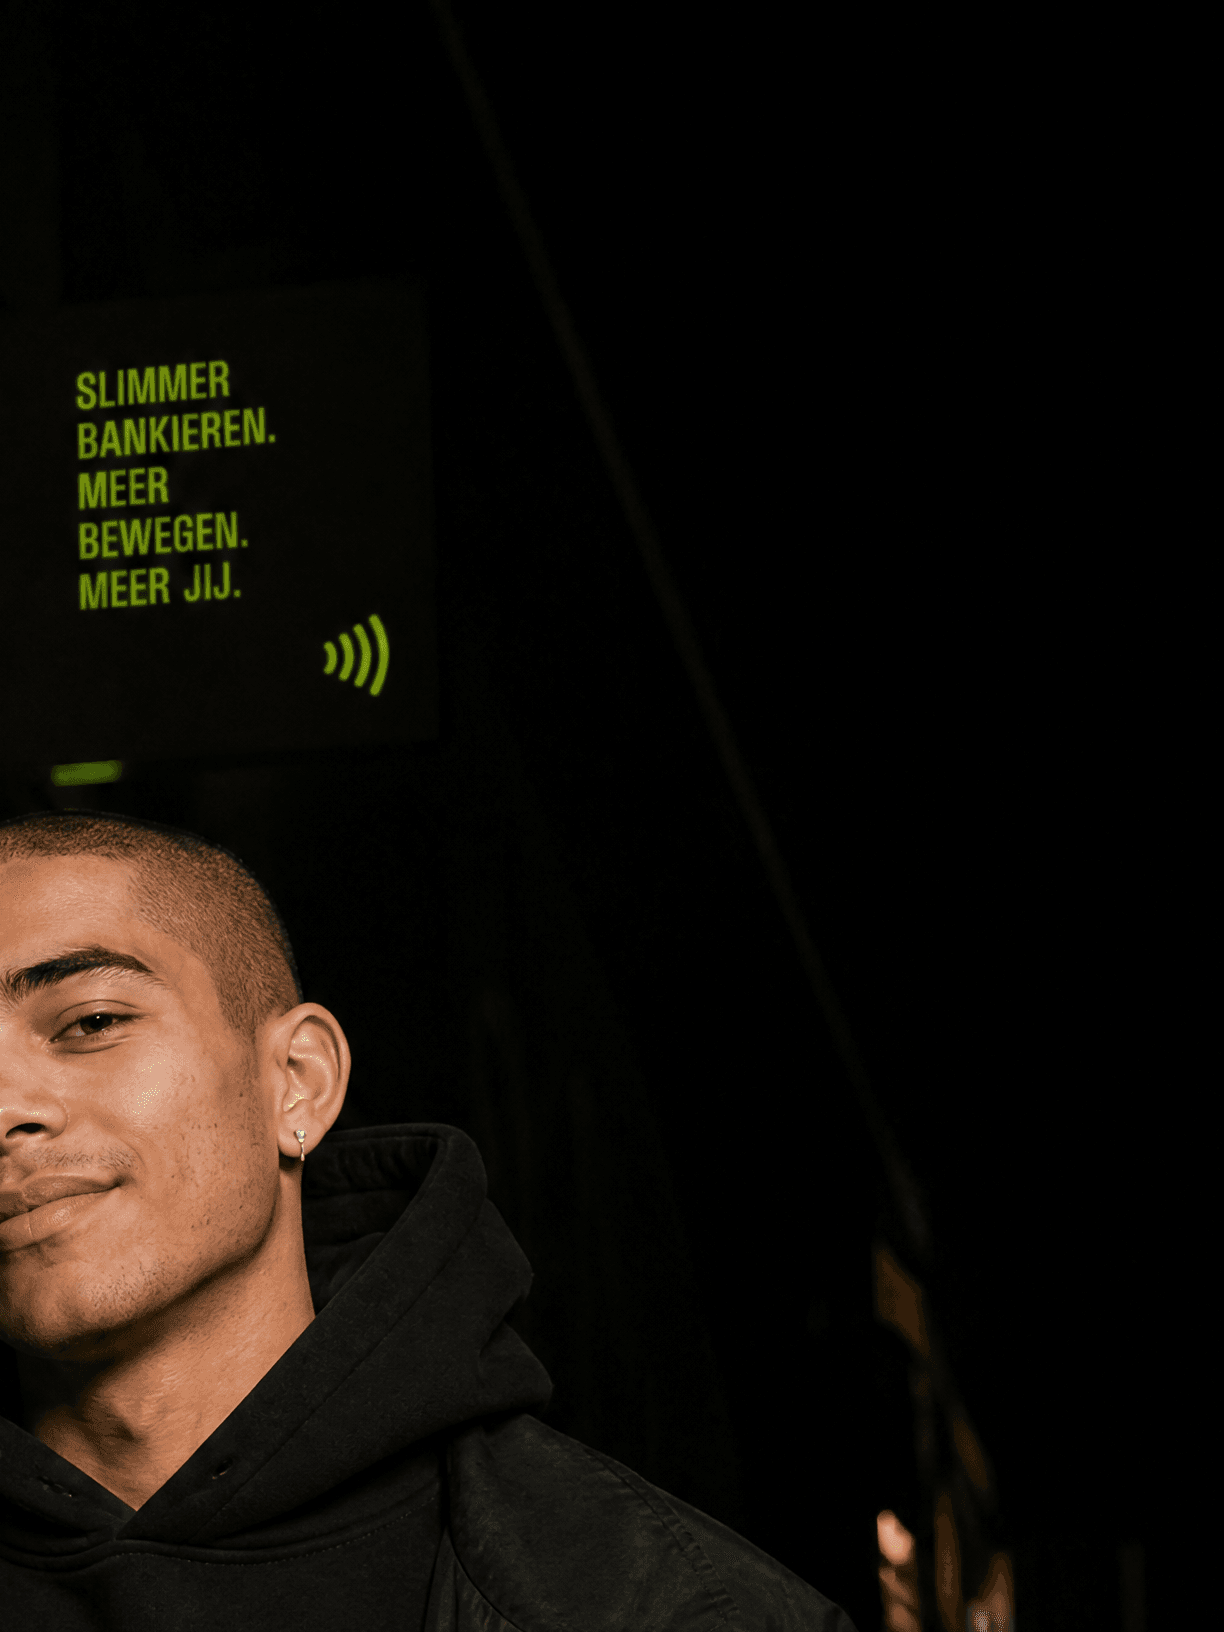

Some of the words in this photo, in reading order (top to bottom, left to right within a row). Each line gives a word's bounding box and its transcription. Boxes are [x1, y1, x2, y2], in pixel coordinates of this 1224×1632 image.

[77, 361, 229, 409] SLIMMER
[78, 408, 275, 459] BANKIEREN.
[79, 467, 168, 509] MEER
[79, 512, 247, 559] BEWEGEN.
[80, 568, 169, 609] MEER
[184, 562, 240, 601] JIJ.
